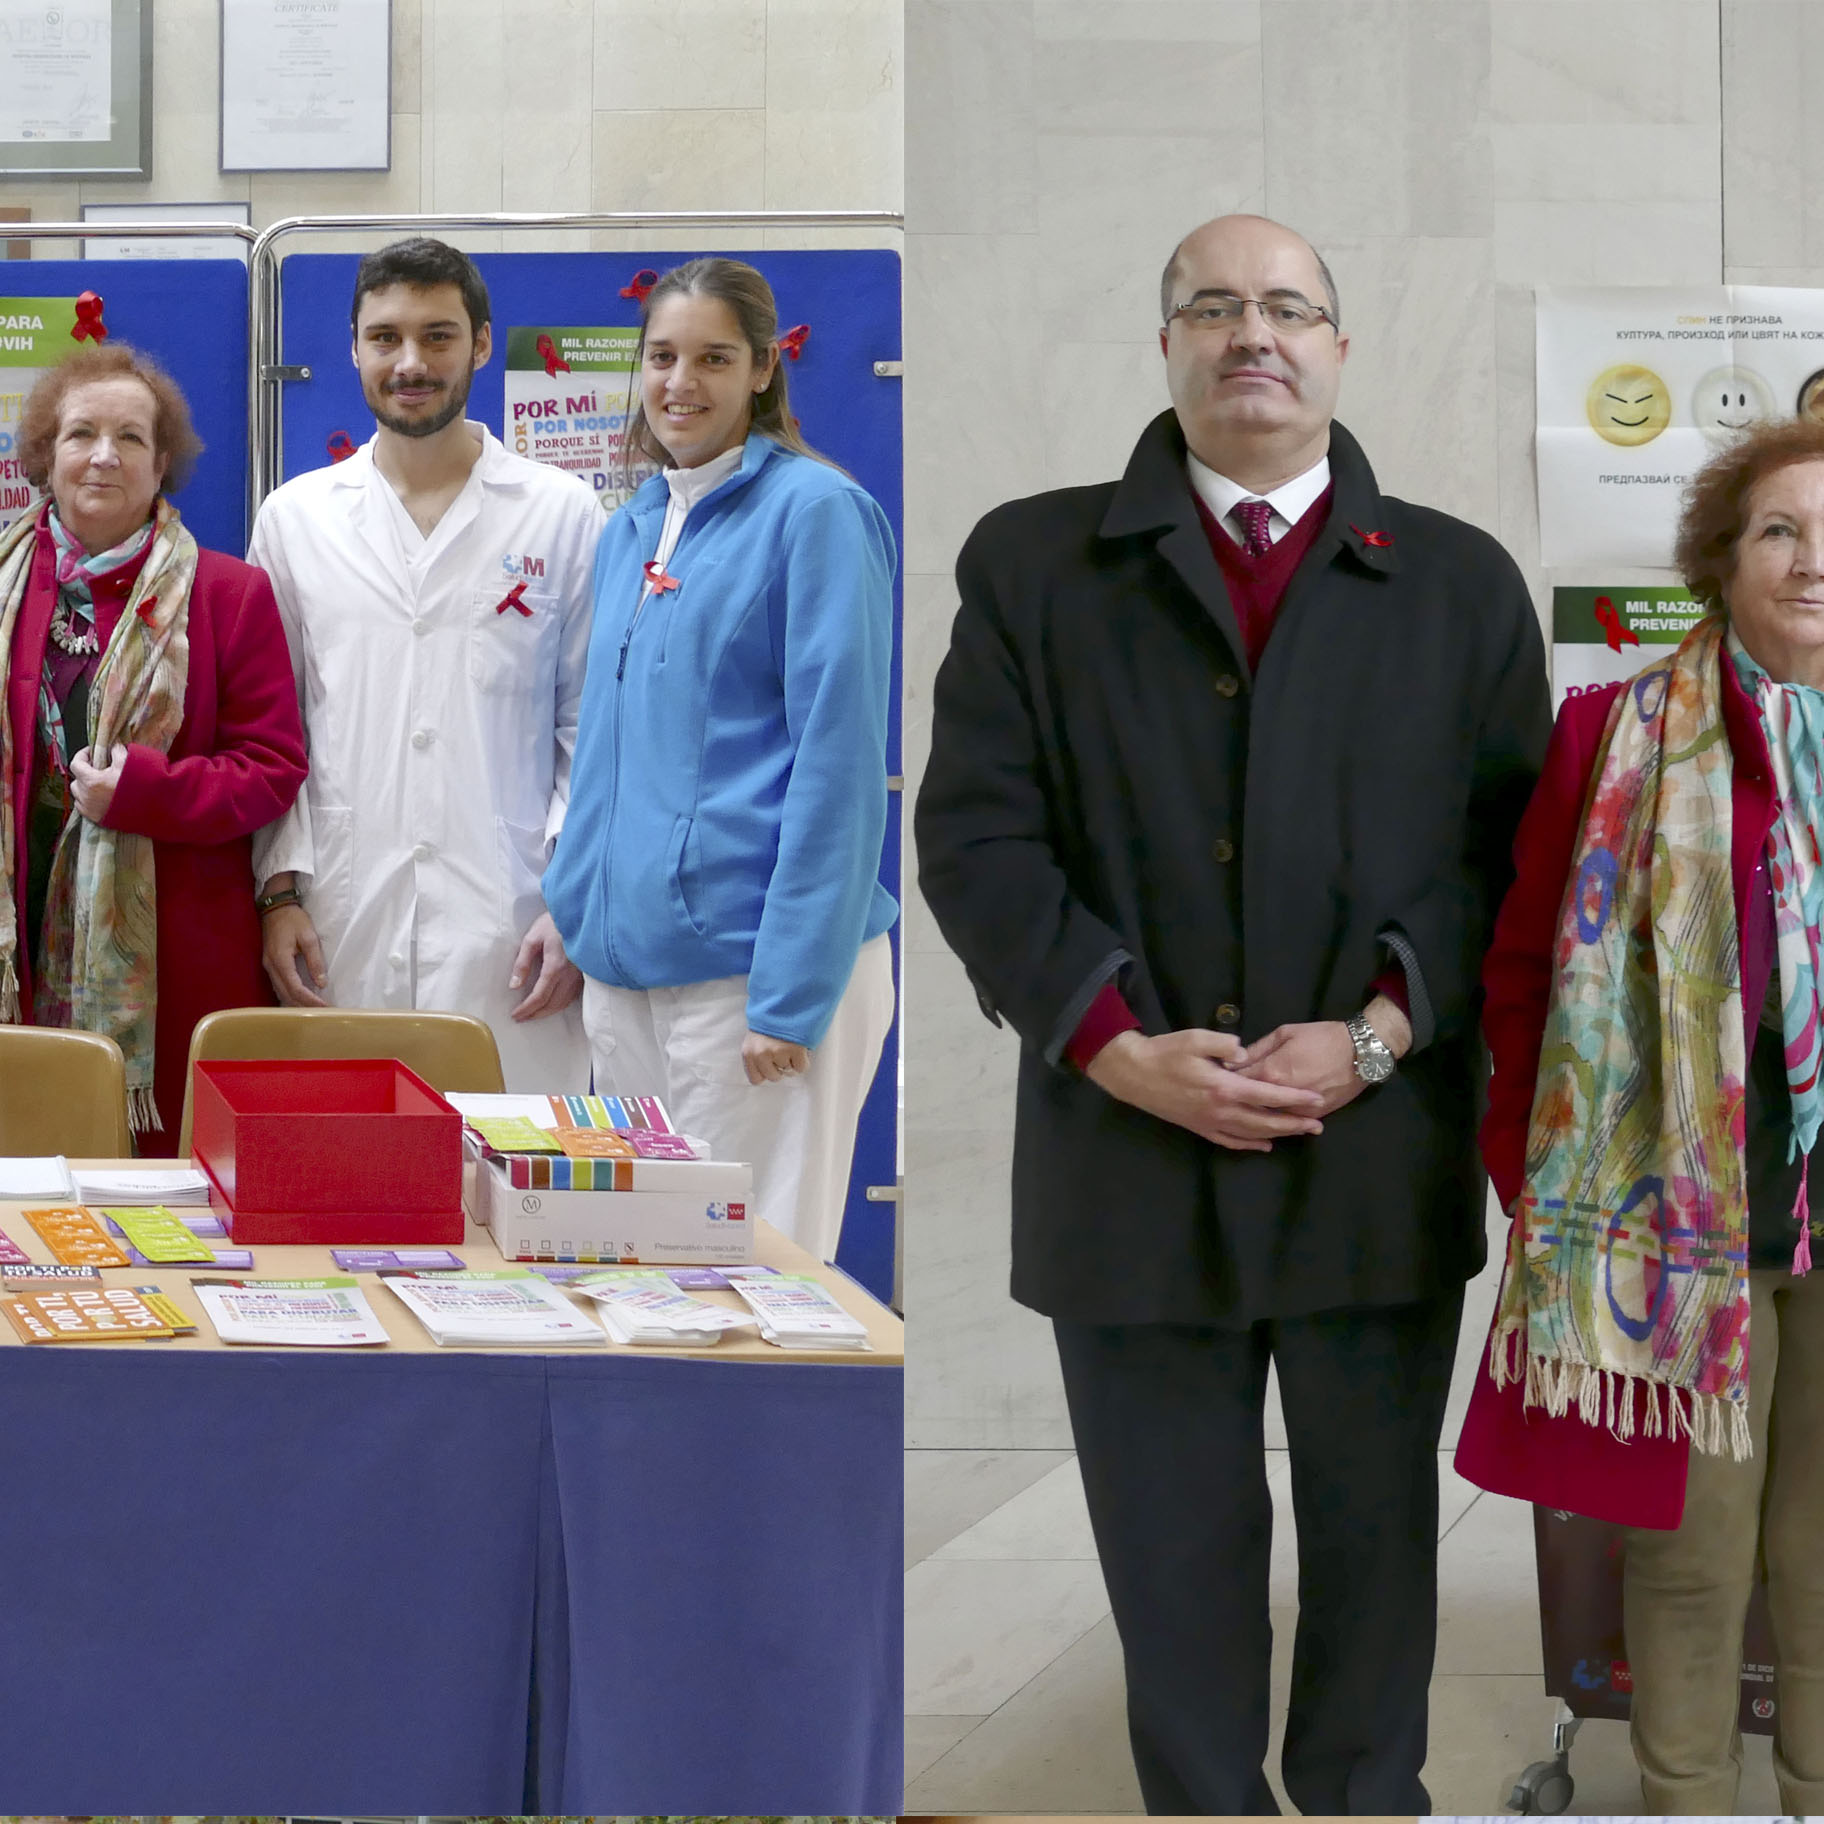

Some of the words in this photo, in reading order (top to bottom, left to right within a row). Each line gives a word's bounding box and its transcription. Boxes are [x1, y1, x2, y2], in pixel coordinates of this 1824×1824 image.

[1709, 316, 1723, 324] НЕ
[1726, 315, 1782, 324] ПРИЗНАВА
[1617, 331, 1665, 341] КУЛТУРА,
[1667, 331, 1725, 341] ПРОИЗХОД
[1728, 331, 1748, 340] ИЛИ
[1751, 331, 1779, 341] ЦВЯТ
[1783, 331, 1798, 340] НА
[1599, 474, 1670, 485] ПРЕДПАЗВАЙ
